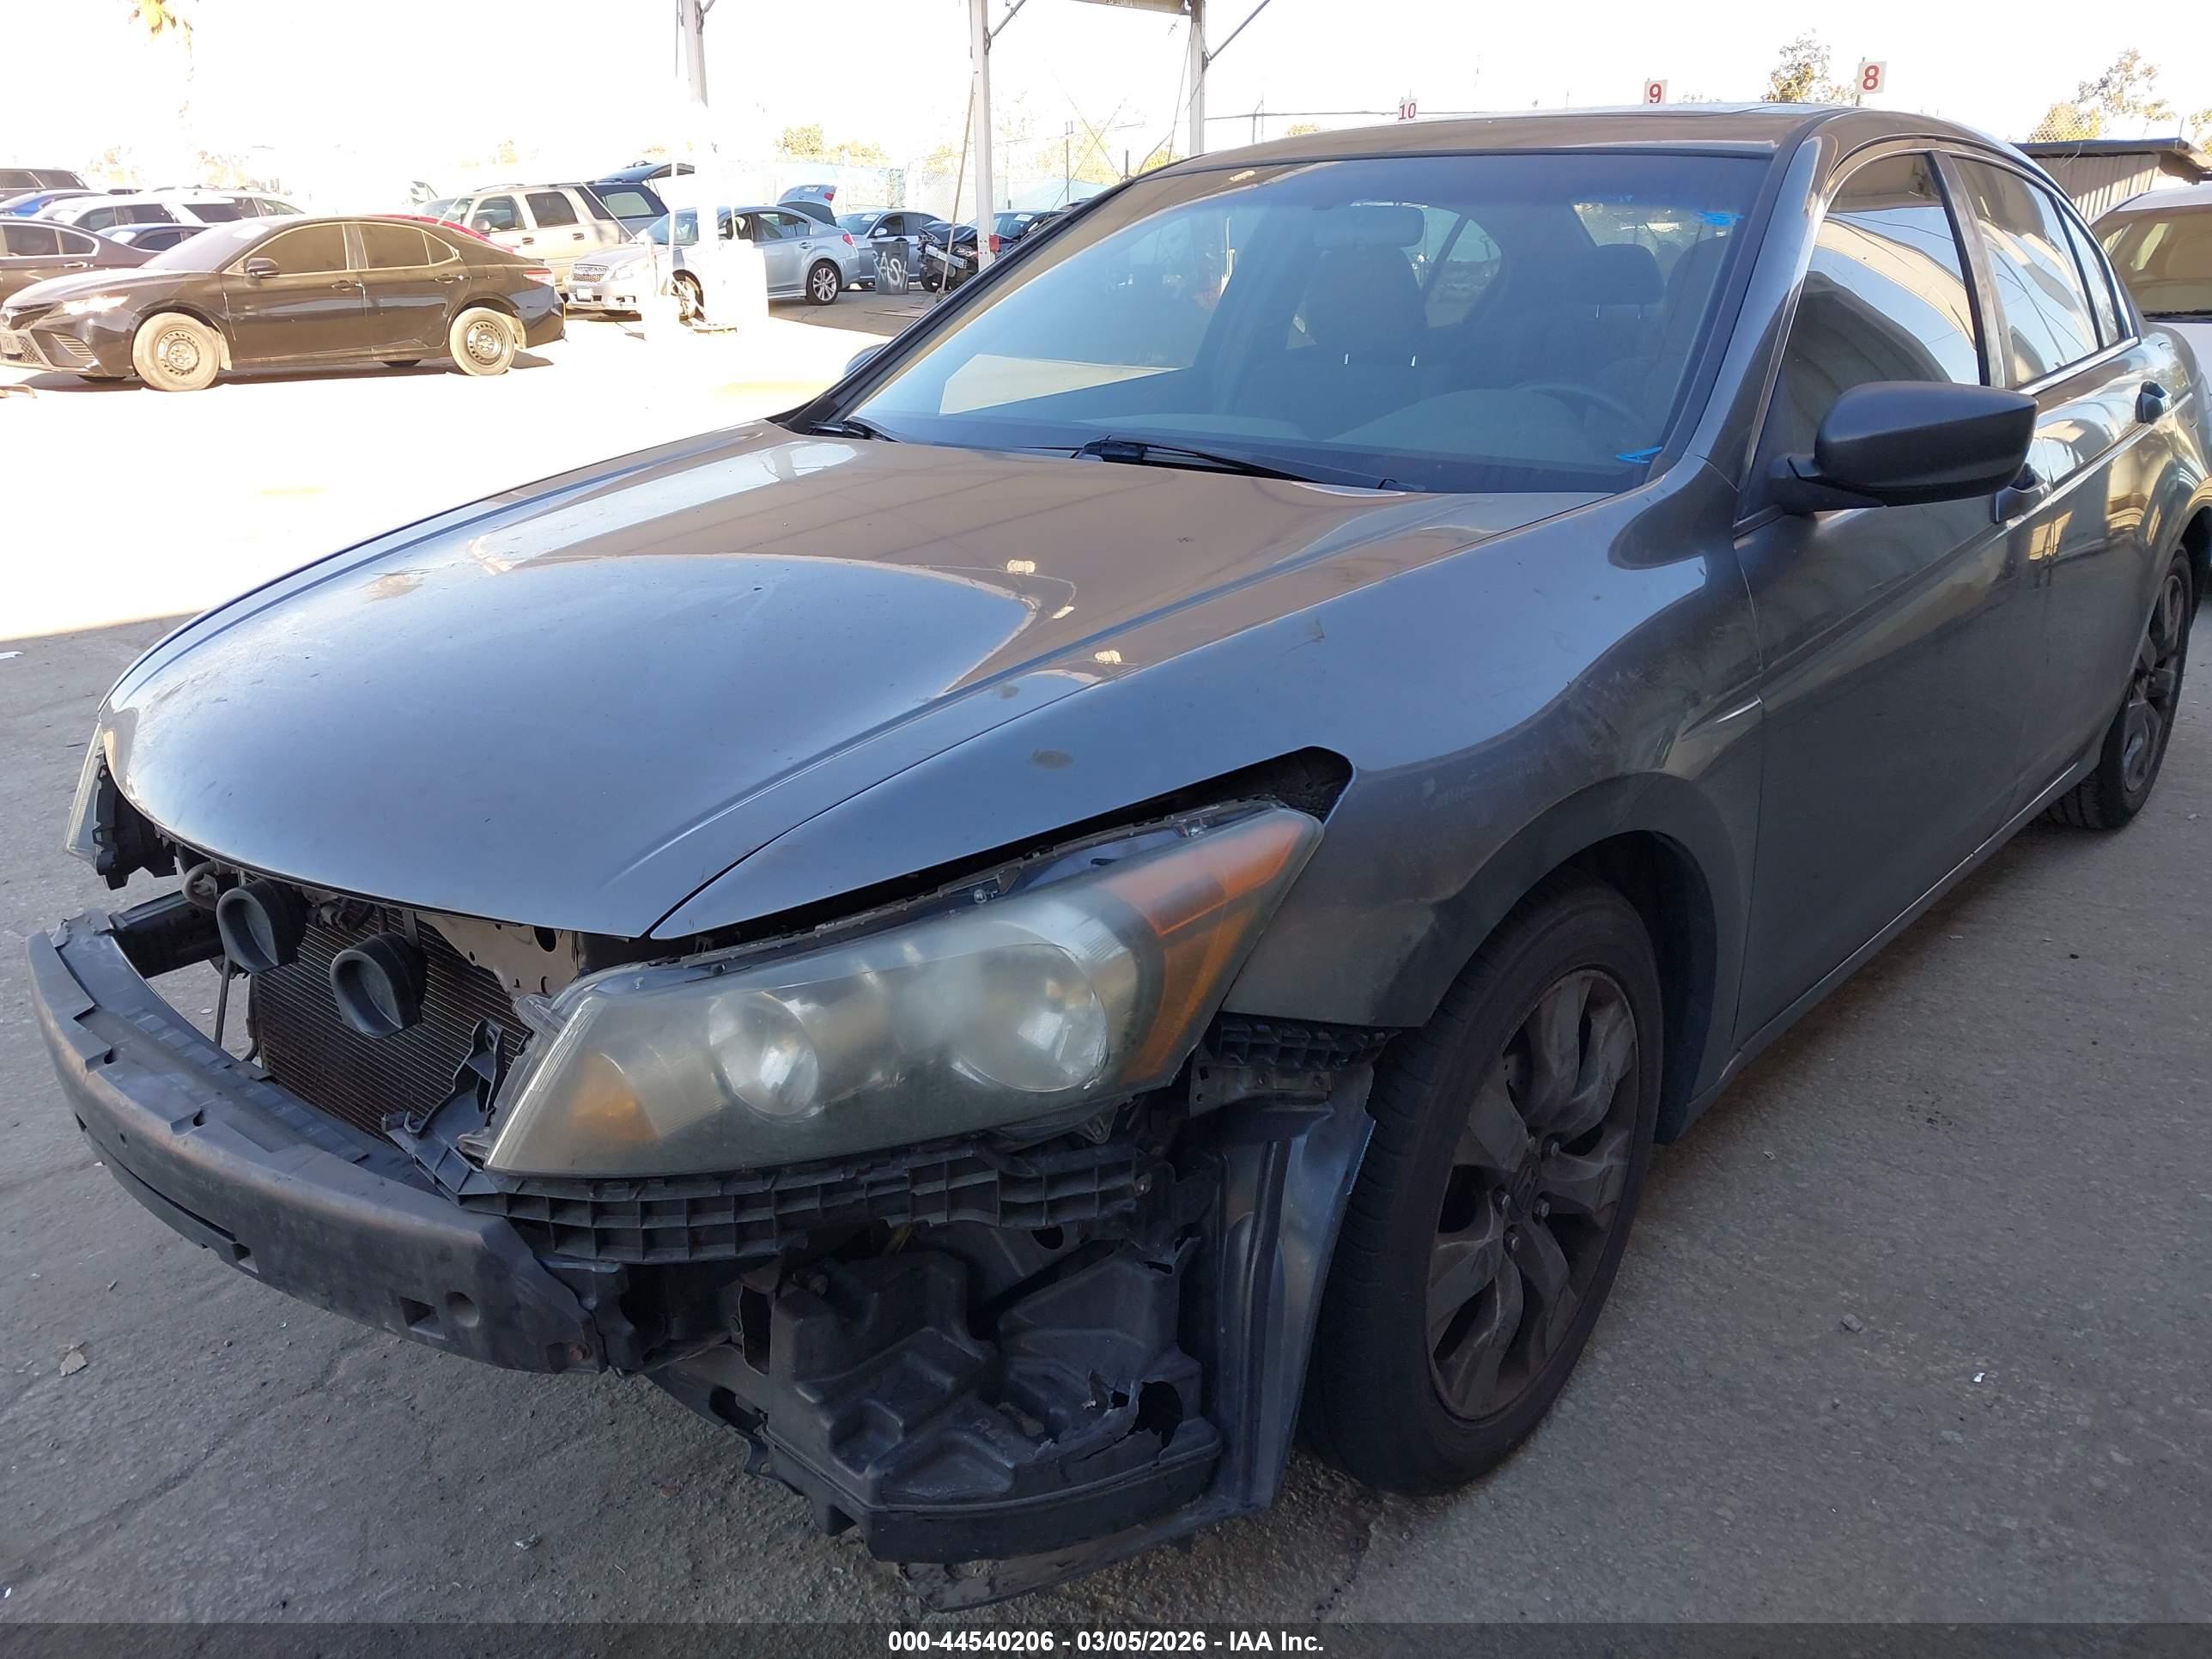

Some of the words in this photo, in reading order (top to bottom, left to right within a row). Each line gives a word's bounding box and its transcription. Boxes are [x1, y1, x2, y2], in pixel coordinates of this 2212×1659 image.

[1863, 65, 1880, 90] 8
[1649, 83, 1662, 104] 9
[1398, 102, 1417, 120] 10
